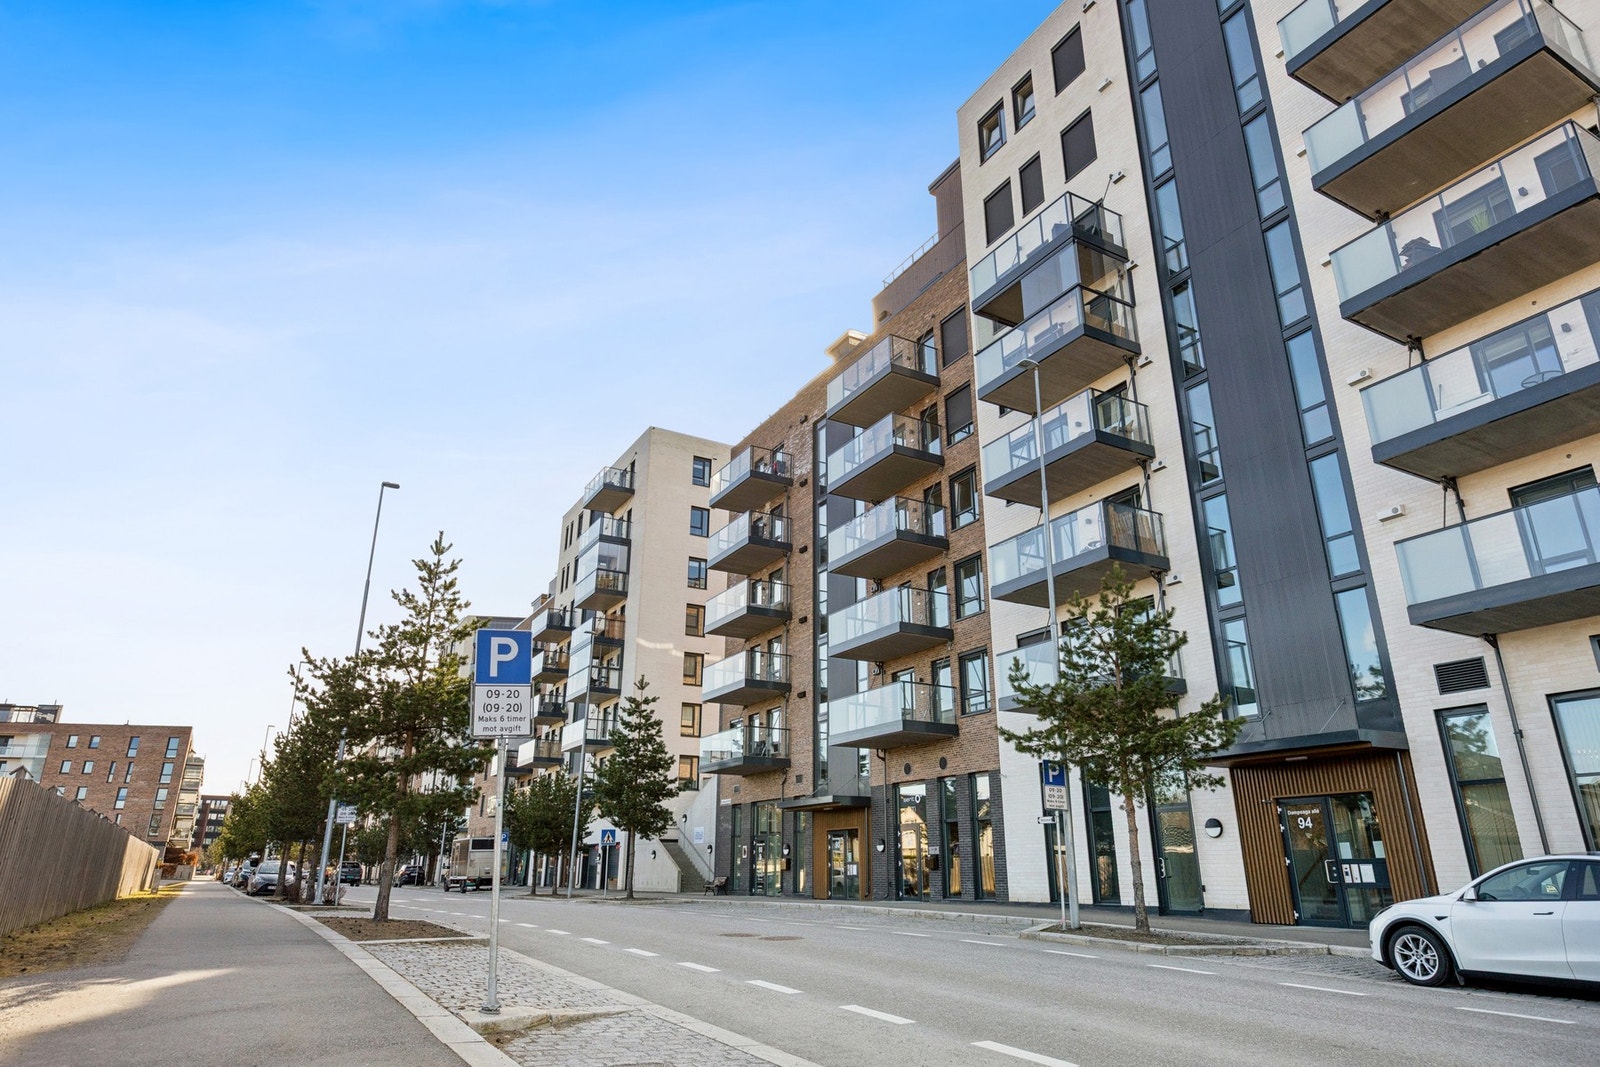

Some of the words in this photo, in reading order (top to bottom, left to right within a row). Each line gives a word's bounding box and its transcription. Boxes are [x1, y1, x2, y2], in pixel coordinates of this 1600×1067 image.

[489, 636, 519, 677] P
[486, 689, 520, 699] 09-20
[482, 702, 523, 713] (09-20)
[499, 724, 522, 733] avgift
[1048, 763, 1060, 783] P
[1297, 816, 1313, 829] 94
